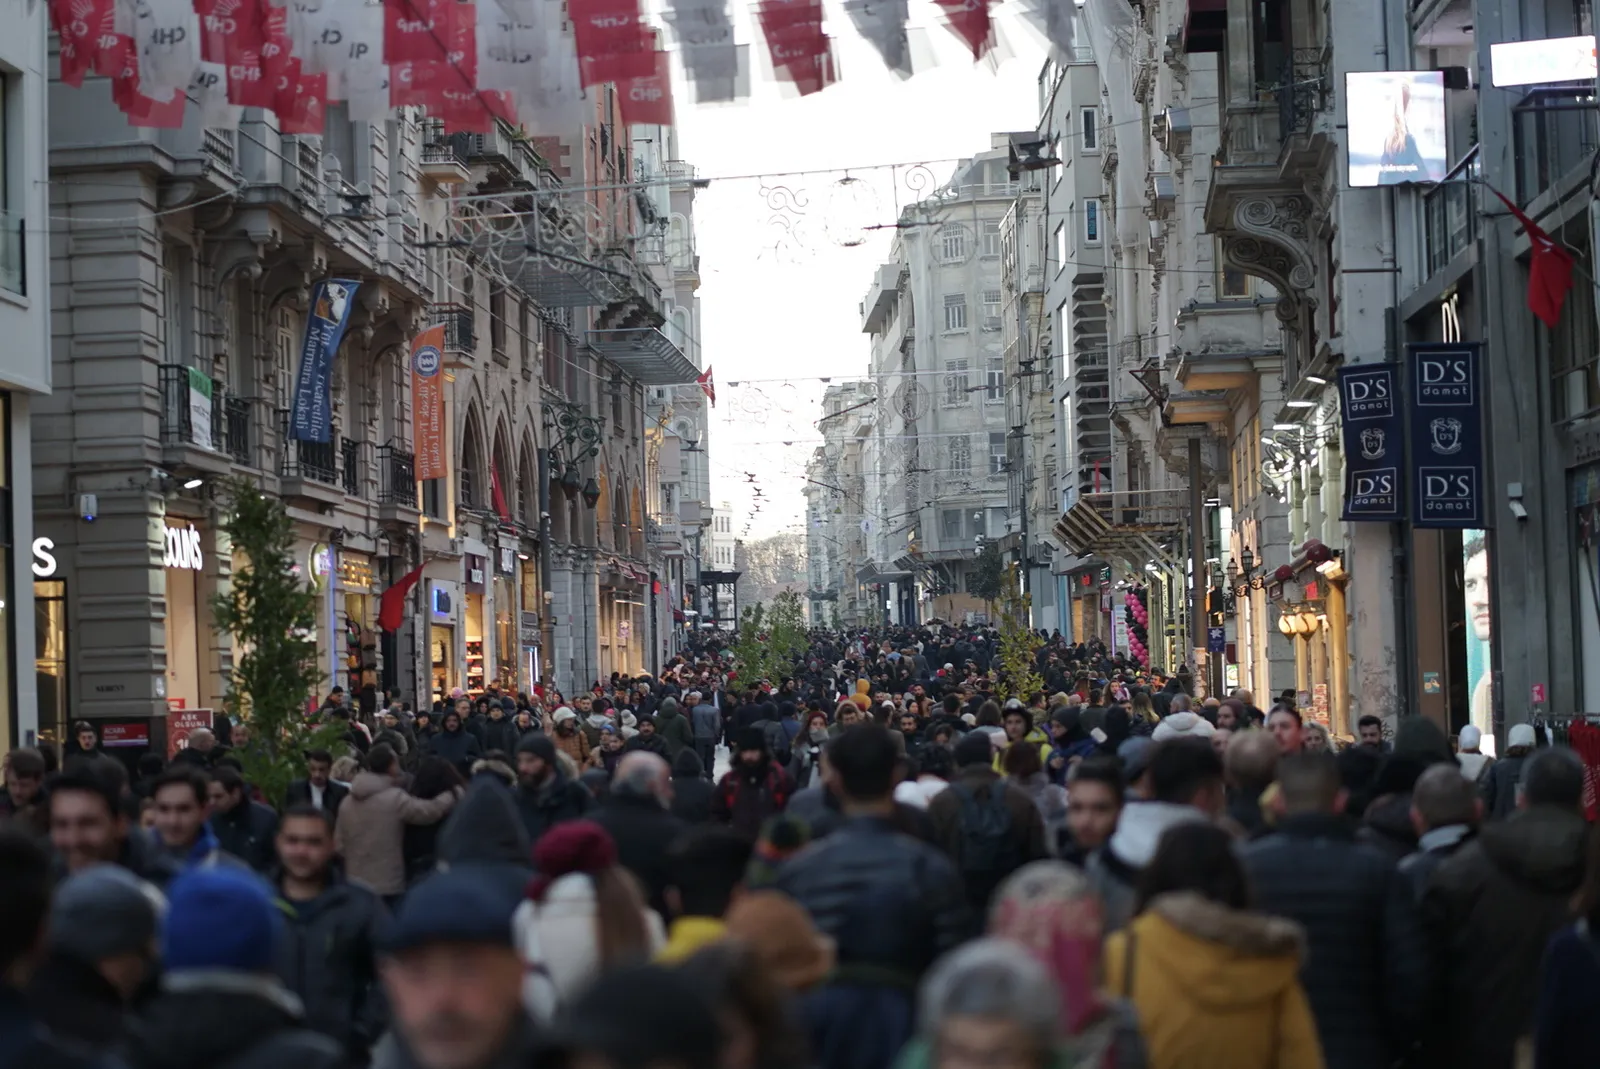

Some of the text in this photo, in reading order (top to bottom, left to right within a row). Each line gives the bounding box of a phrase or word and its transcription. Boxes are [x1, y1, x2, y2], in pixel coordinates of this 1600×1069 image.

[629, 87, 662, 101] CHP
[319, 323, 336, 368] Yükk
[295, 326, 321, 430] Marmara Lokali
[1422, 360, 1466, 382] D'S
[1348, 379, 1387, 400] D'S
[1422, 386, 1468, 395] damat
[1351, 400, 1389, 411] damat
[1356, 475, 1392, 496] D'S
[1425, 474, 1469, 497] D'S
[1354, 496, 1392, 505] damat
[1426, 501, 1470, 510] damat
